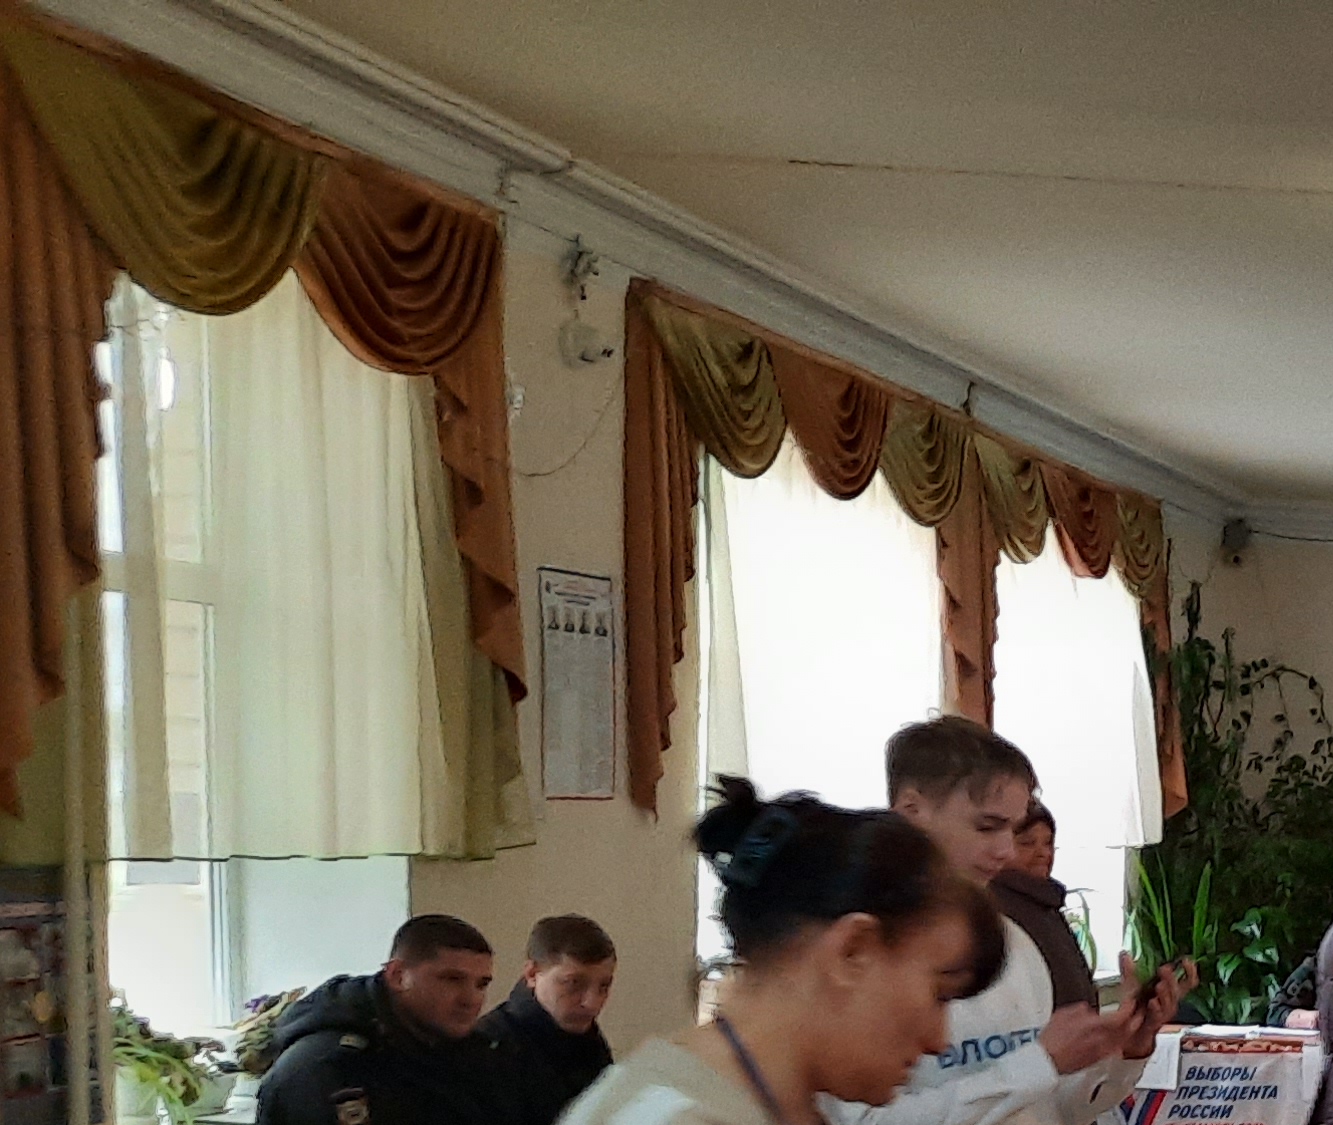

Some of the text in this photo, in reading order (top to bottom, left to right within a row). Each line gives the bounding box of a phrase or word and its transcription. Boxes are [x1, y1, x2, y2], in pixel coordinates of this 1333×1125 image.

[1185, 1065, 1257, 1081] ВЫБОРЫ
[1175, 1084, 1278, 1102] ПРЕЗИДЕНТА
[1167, 1103, 1234, 1119] РОССИИ
